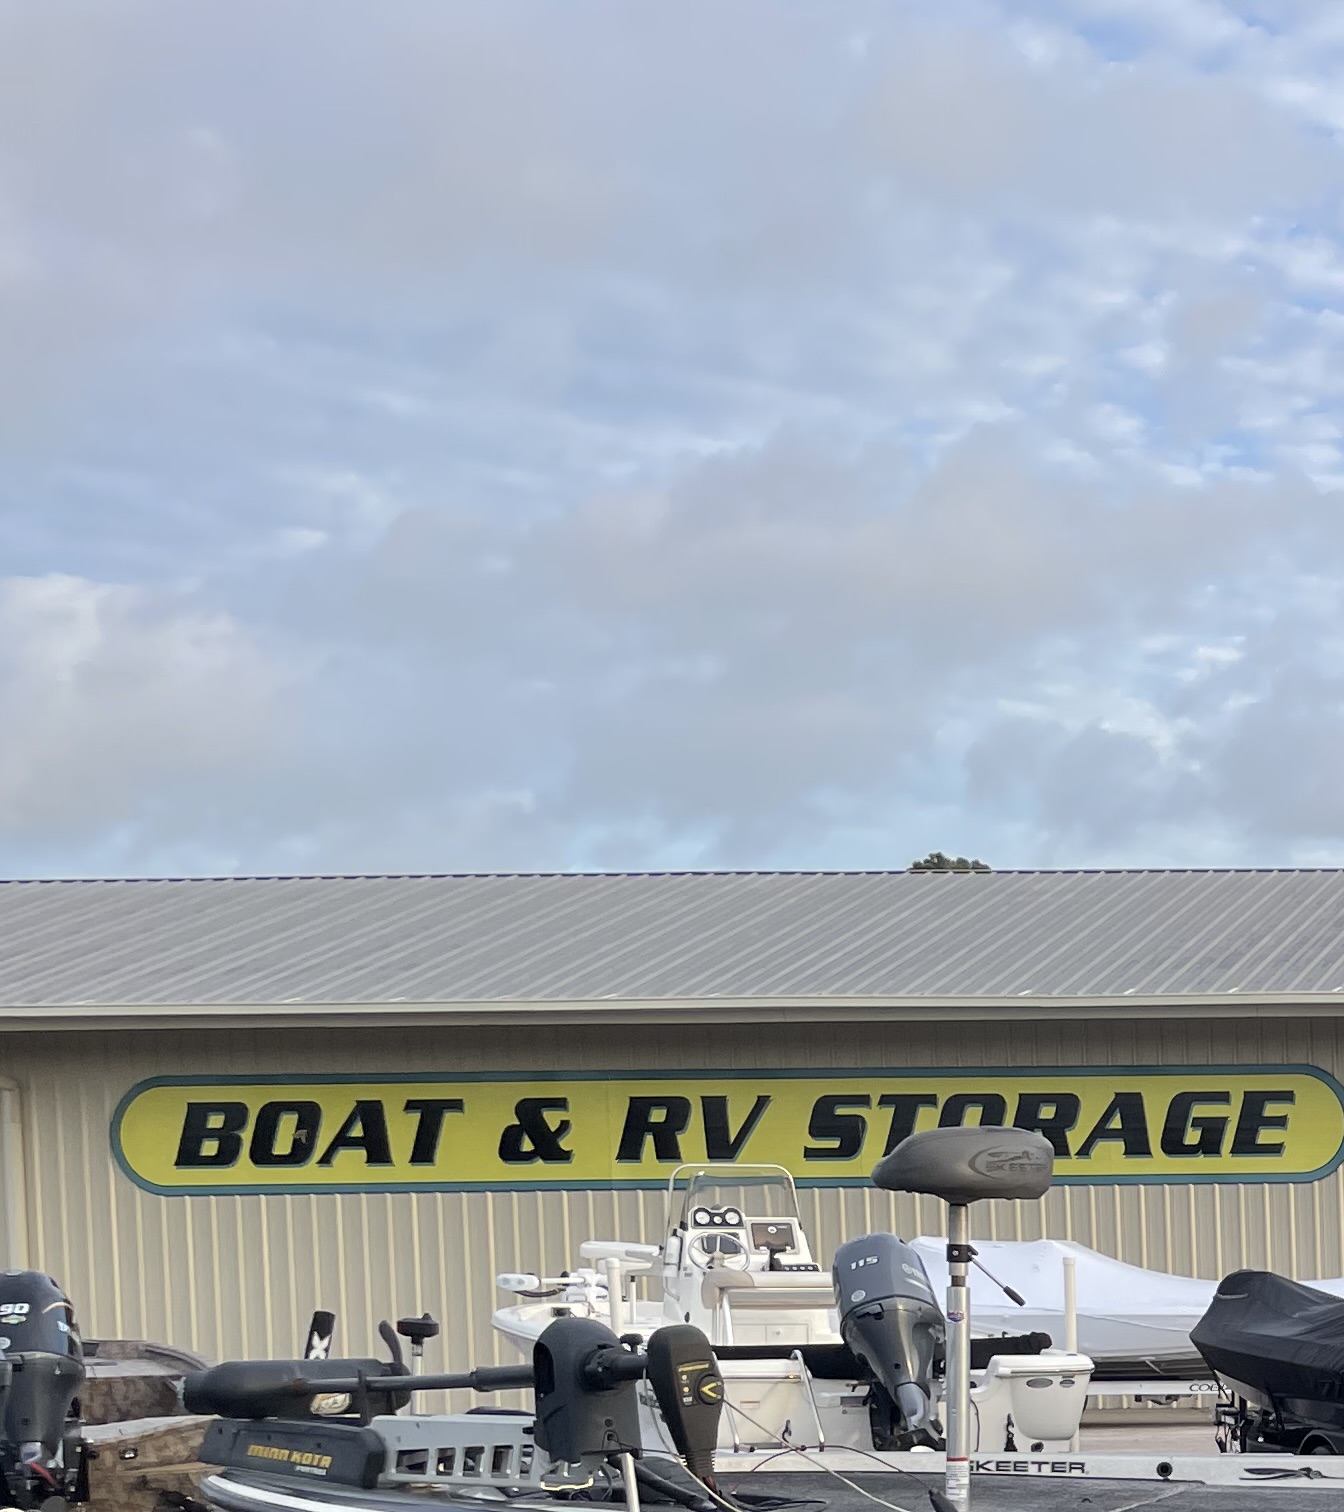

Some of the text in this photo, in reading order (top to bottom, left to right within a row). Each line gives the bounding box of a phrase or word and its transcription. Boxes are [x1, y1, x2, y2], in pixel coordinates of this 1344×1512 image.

[173, 1090, 1297, 1169] BOAT & RV STORAGE
[850, 1255, 879, 1270] 115
[290, 1452, 333, 1469] KOTA
[970, 1460, 1086, 1474] KEETER
